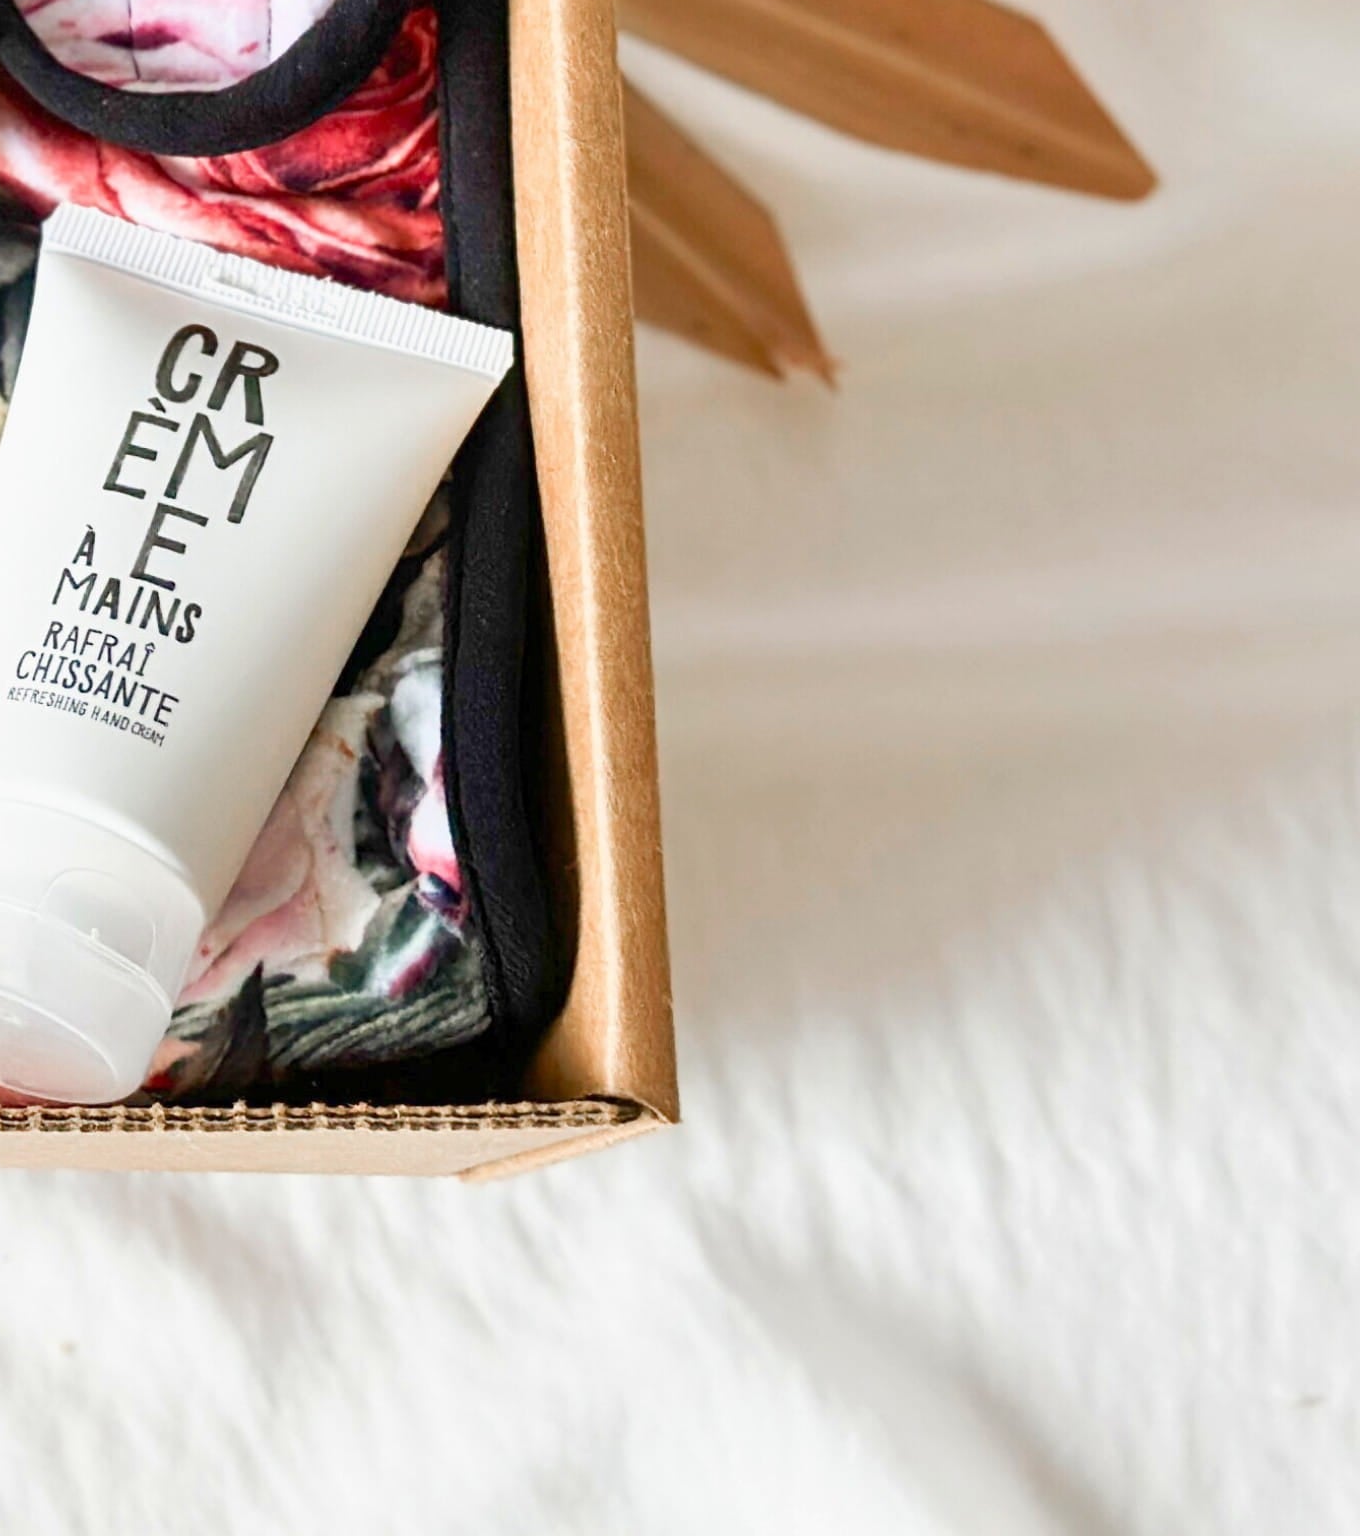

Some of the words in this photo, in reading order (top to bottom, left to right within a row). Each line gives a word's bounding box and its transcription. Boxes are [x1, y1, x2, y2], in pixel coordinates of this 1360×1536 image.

[71, 523, 97, 567] À
[51, 567, 203, 645] MAINS
[42, 620, 157, 678] RAFRAÎ
[6, 686, 89, 717] REFRESHING
[90, 704, 131, 732] HAND
[130, 720, 166, 748] CREAM
[15, 650, 180, 728] CHISSANTE
